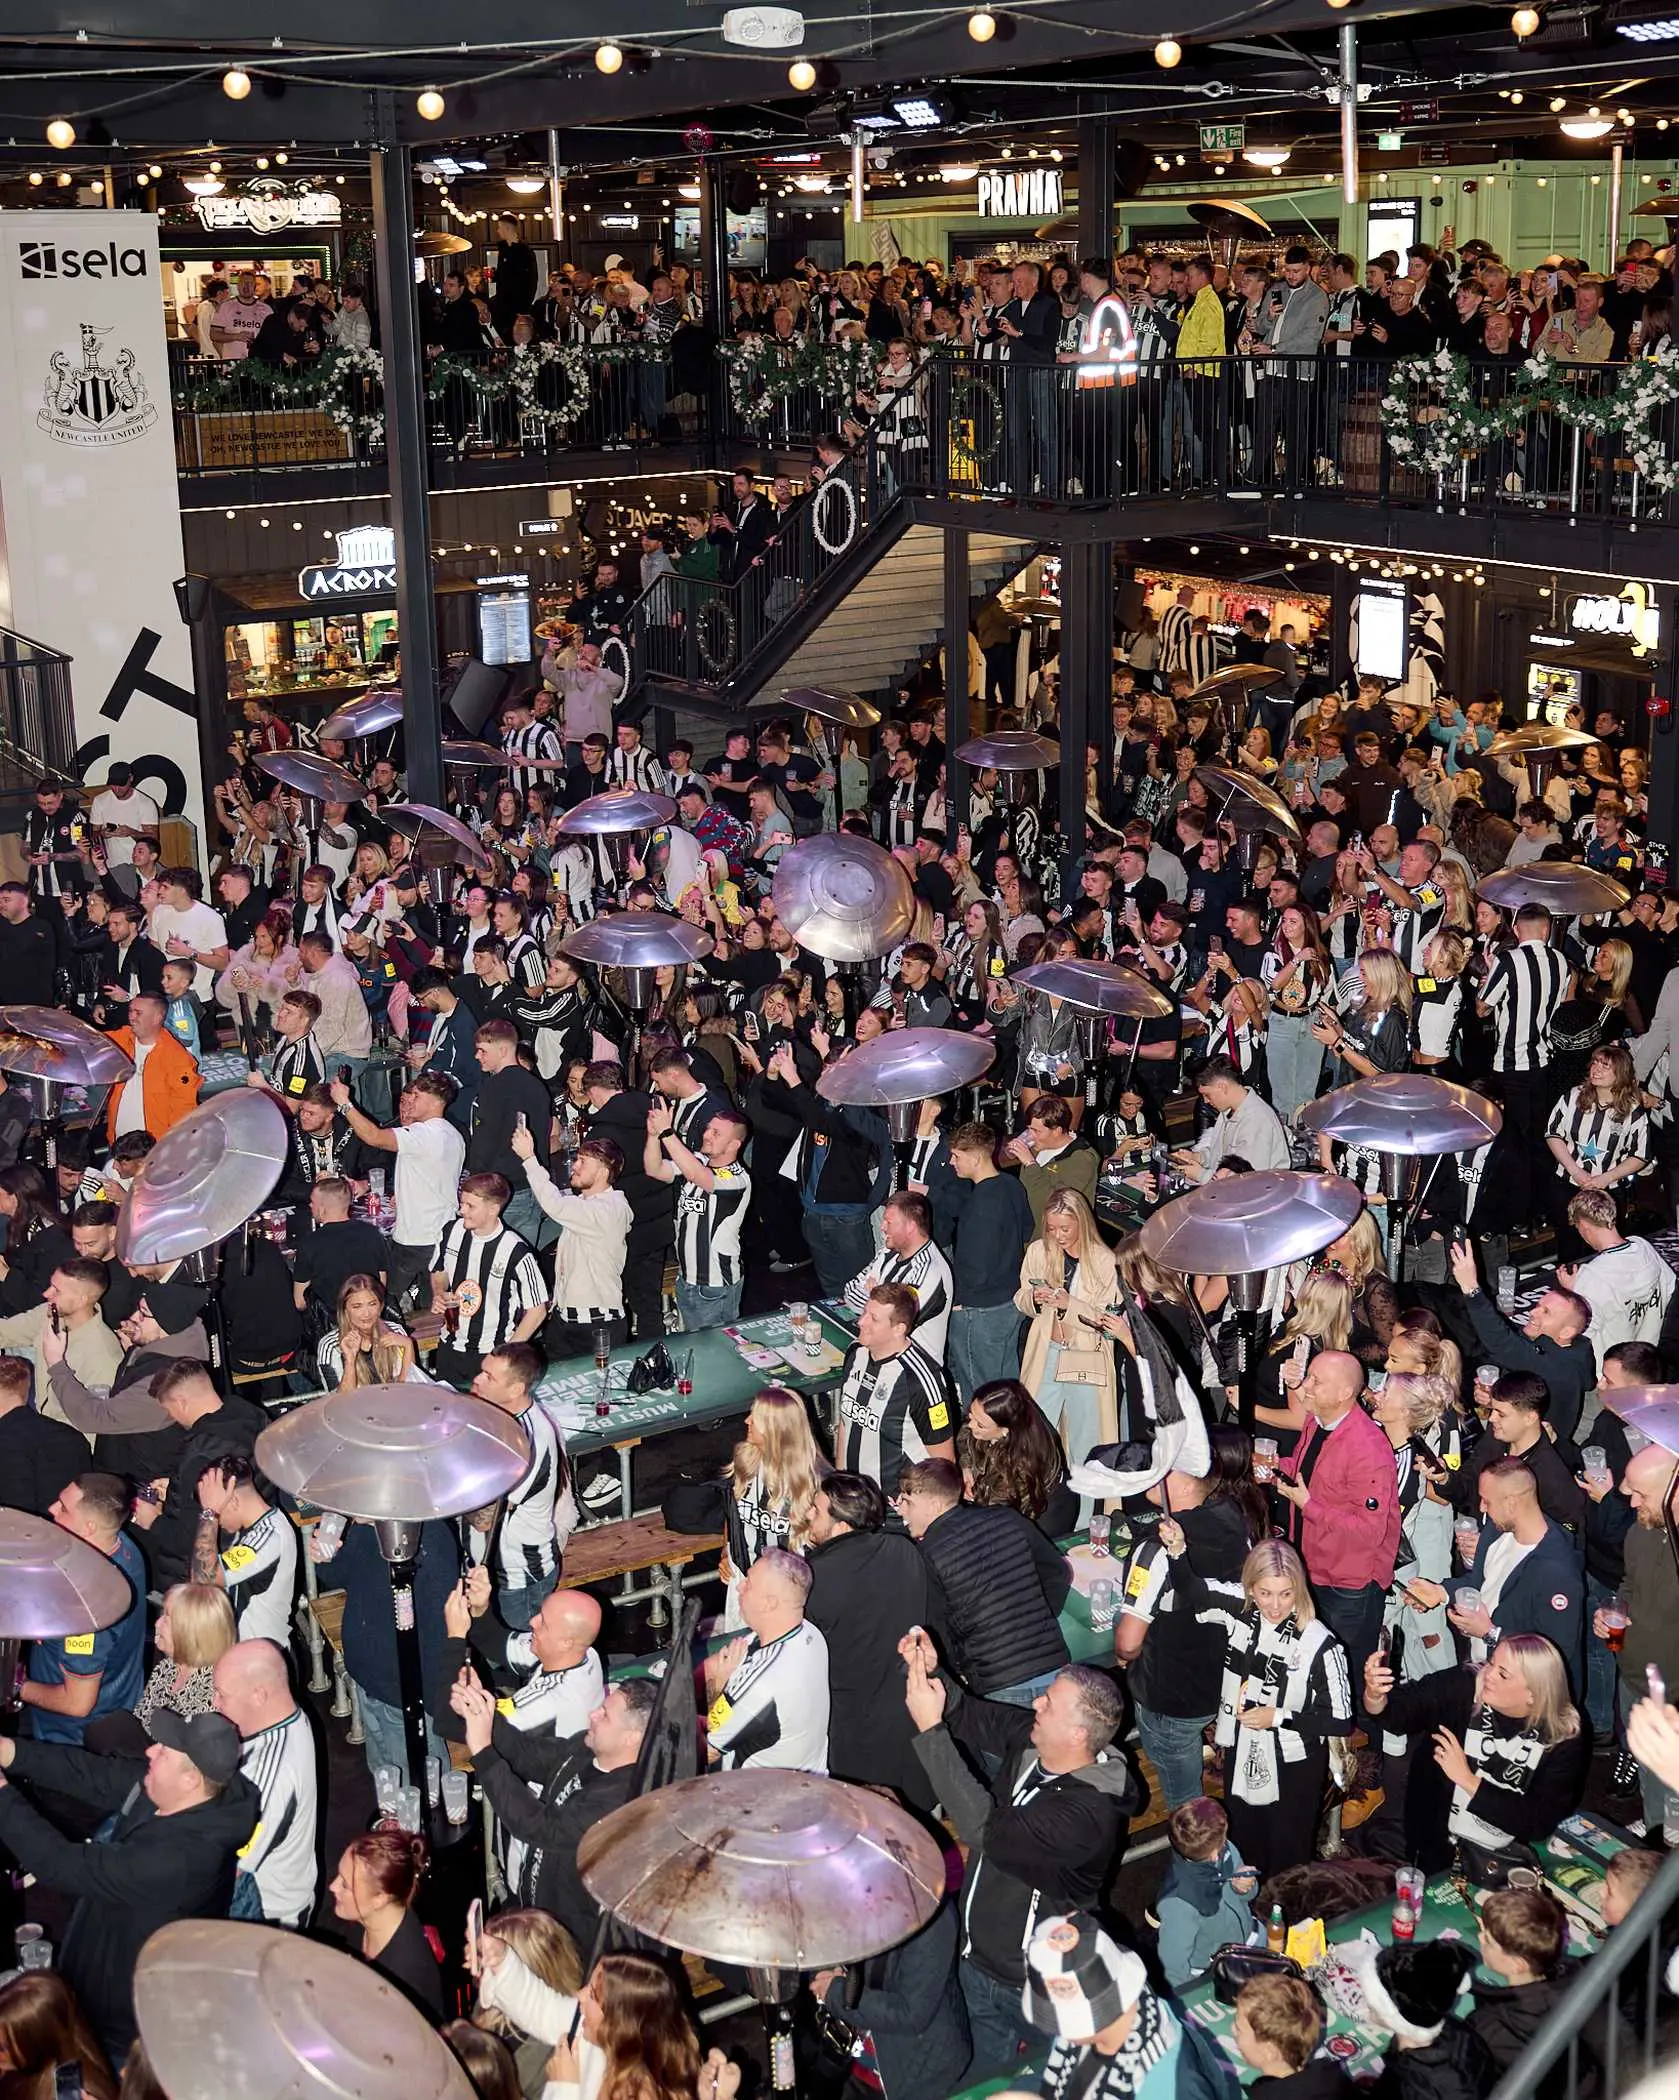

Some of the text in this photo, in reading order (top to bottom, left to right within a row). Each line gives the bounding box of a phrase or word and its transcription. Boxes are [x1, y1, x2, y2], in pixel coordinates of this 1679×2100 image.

[978, 171, 1060, 217] PRAVHA
[61, 241, 147, 280] sela
[55, 424, 144, 443] NEWCASTLE UNITED
[619, 1402, 680, 1424] MUST
[851, 1402, 881, 1432] sela
[749, 1507, 791, 1535] sela
